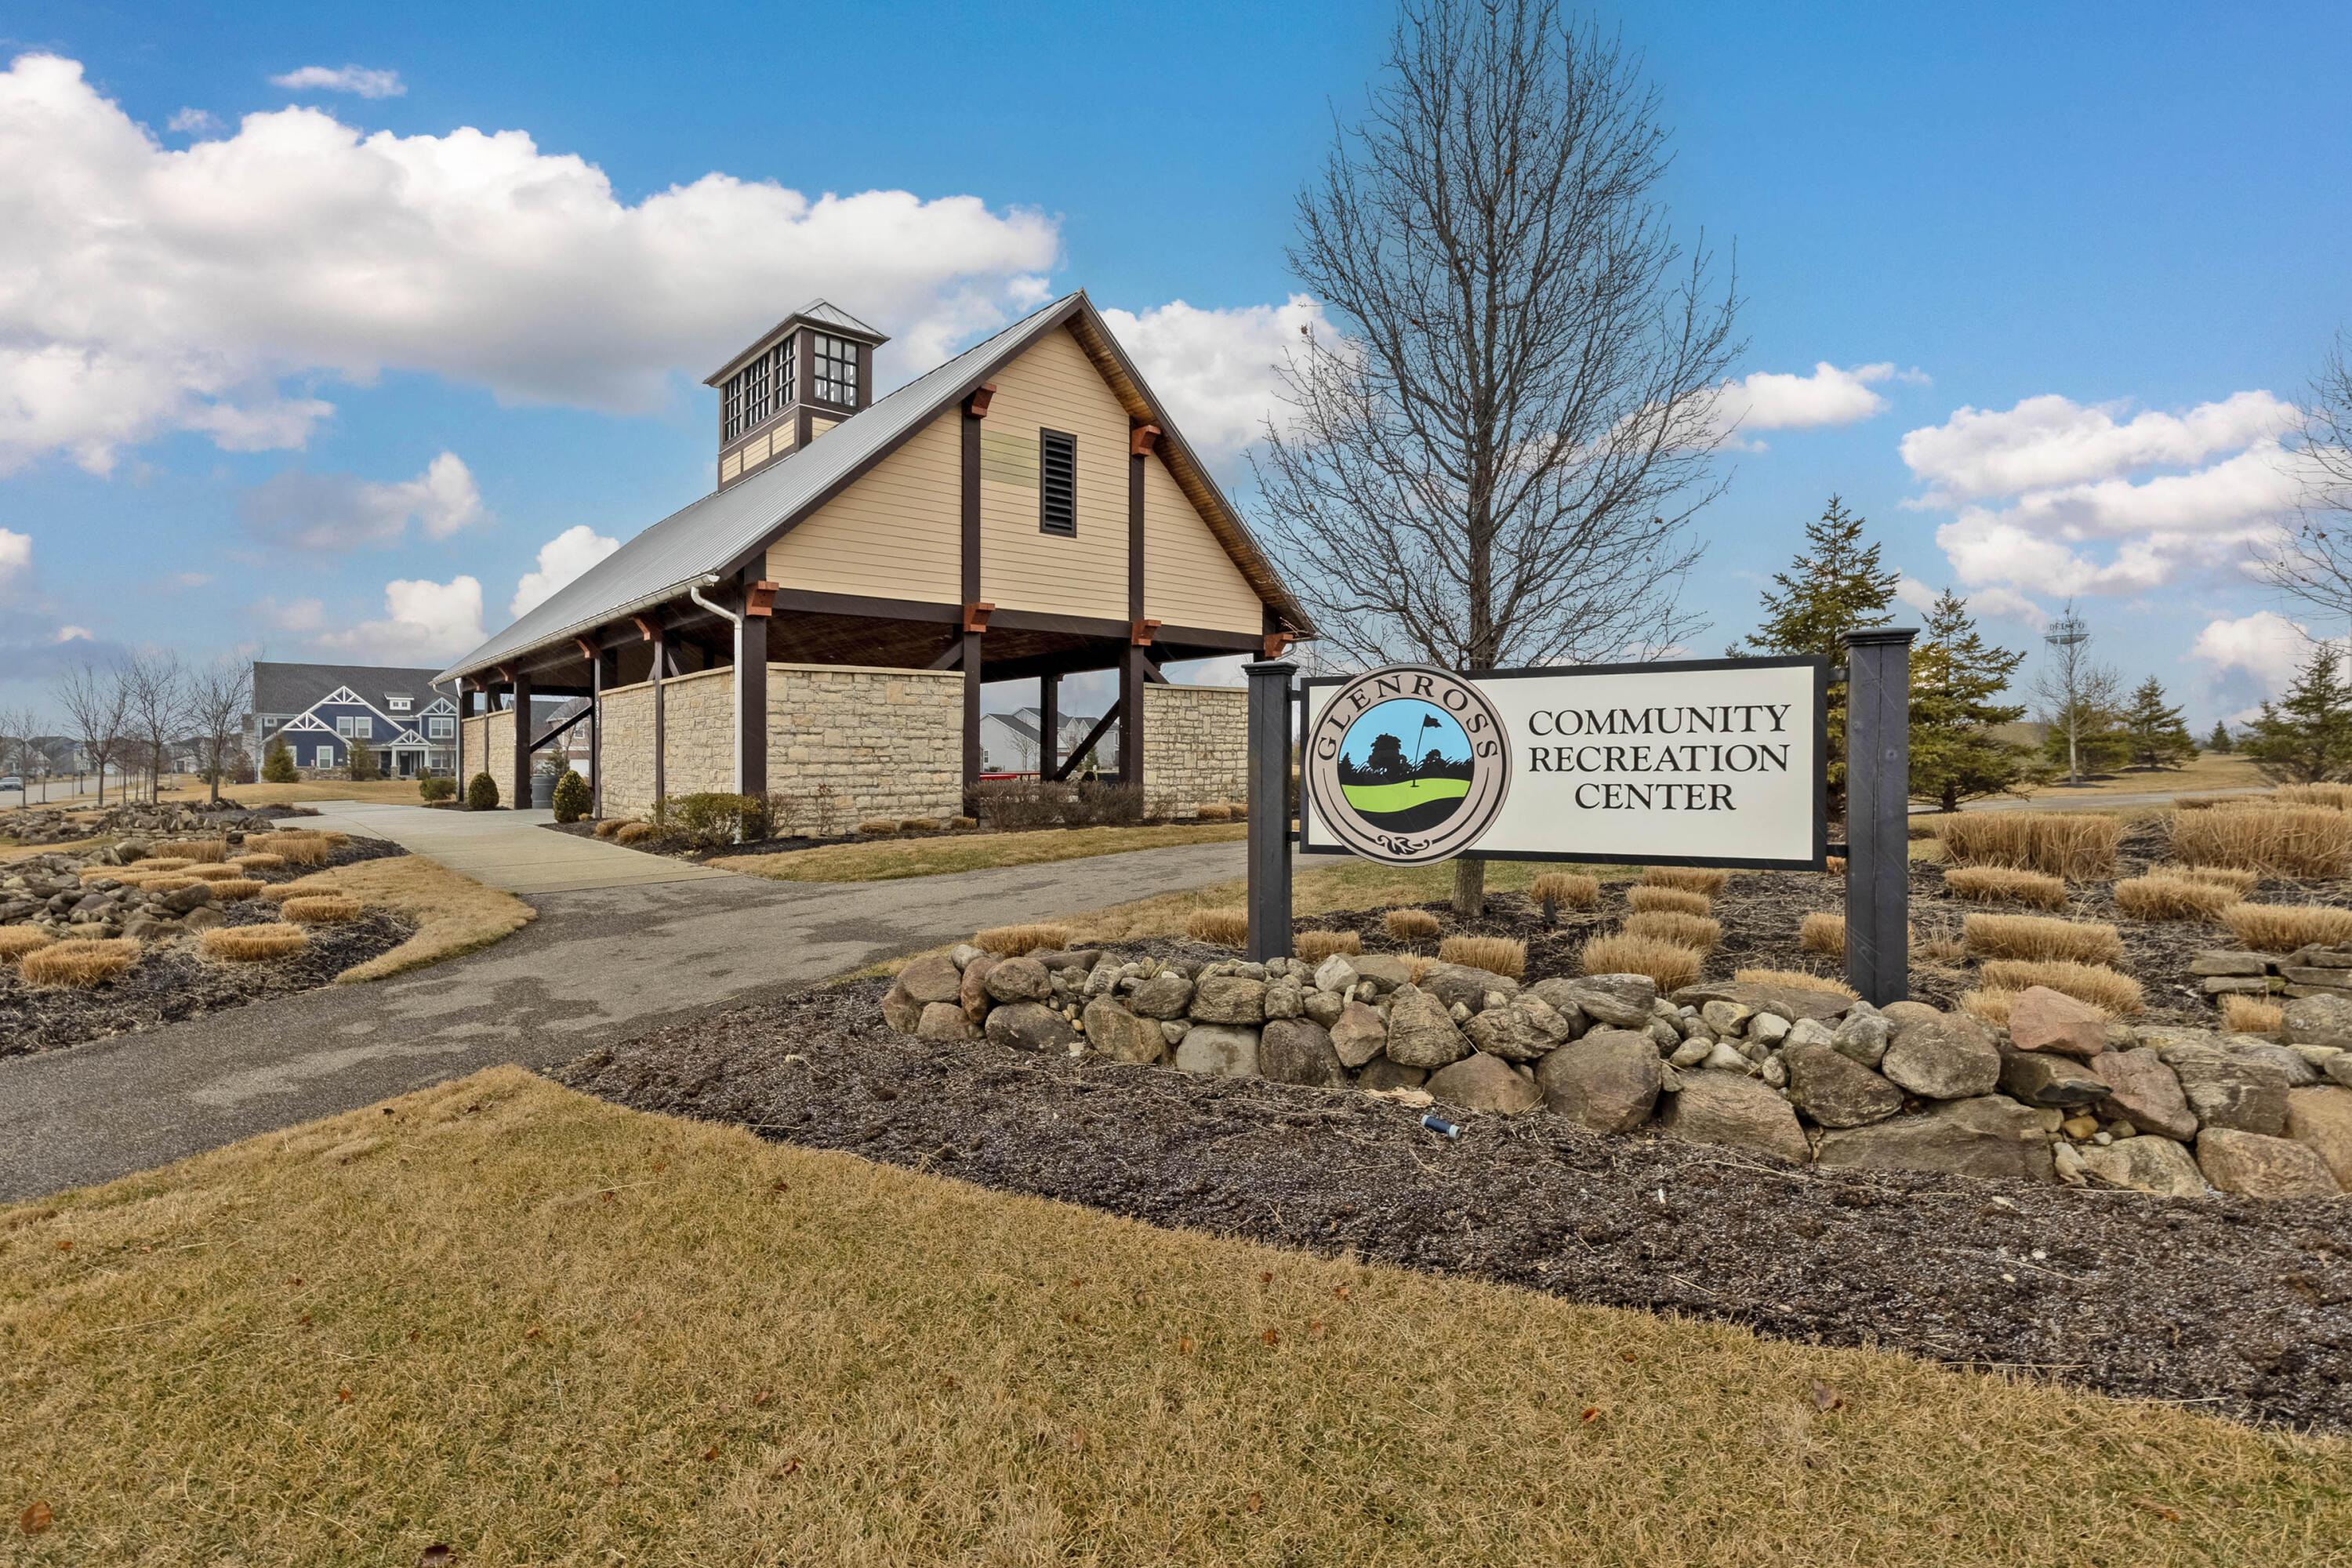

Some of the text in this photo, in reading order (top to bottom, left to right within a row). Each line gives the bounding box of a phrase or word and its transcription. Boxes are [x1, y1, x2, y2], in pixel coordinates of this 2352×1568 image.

[1317, 673, 1498, 761] GLENROSS
[1529, 704, 1791, 736] COMMUNITY
[1529, 744, 1791, 772] RECREATION
[1574, 783, 1737, 811] CENTER
